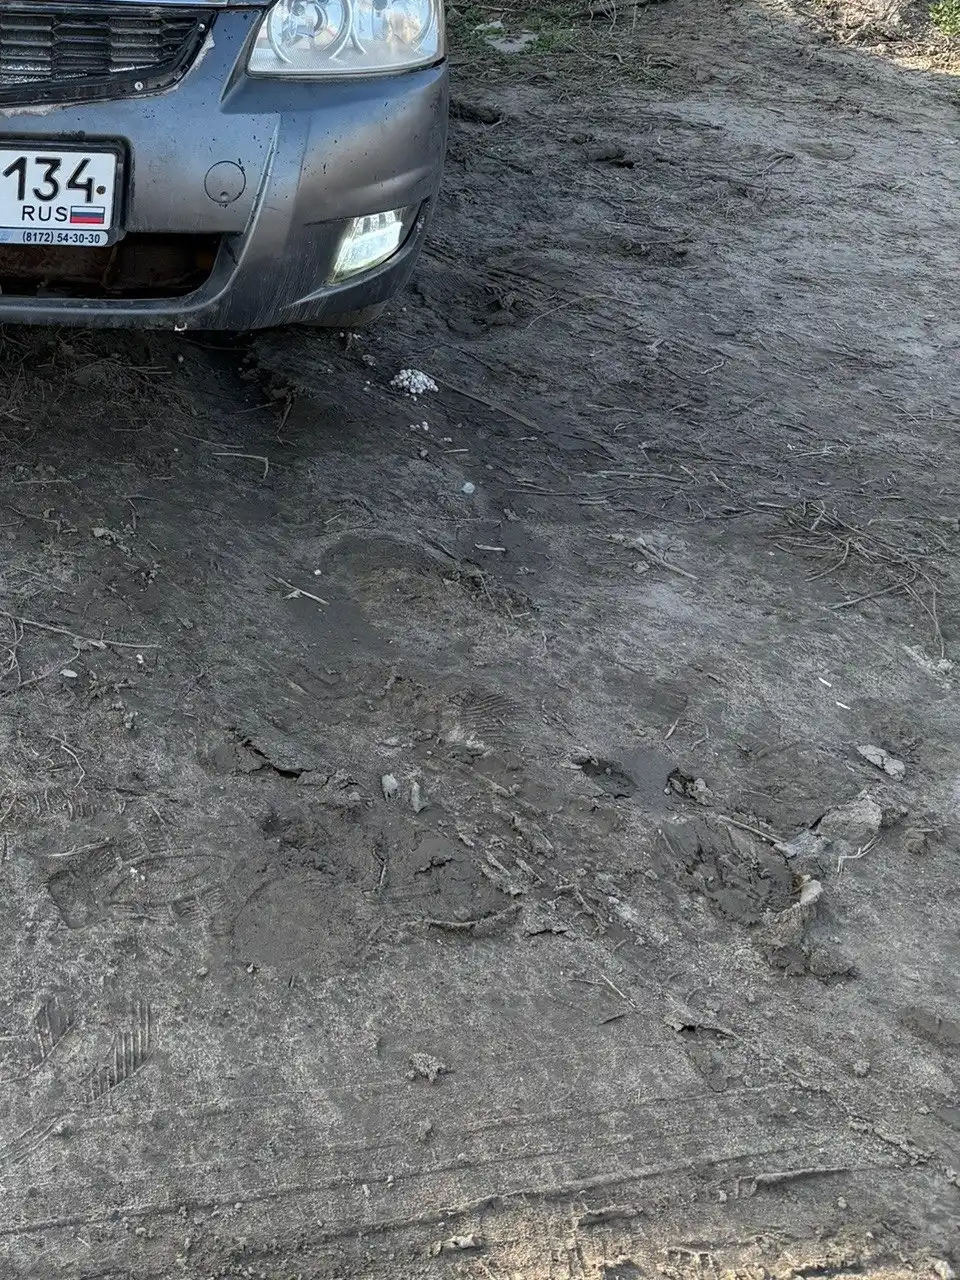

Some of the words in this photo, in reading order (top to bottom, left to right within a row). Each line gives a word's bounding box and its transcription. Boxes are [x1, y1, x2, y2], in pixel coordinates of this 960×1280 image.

[2, 156, 95, 203] 134
[21, 205, 68, 222] RUS
[22, 230, 54, 243] (8172)
[57, 232, 101, 244] 54-30-30
